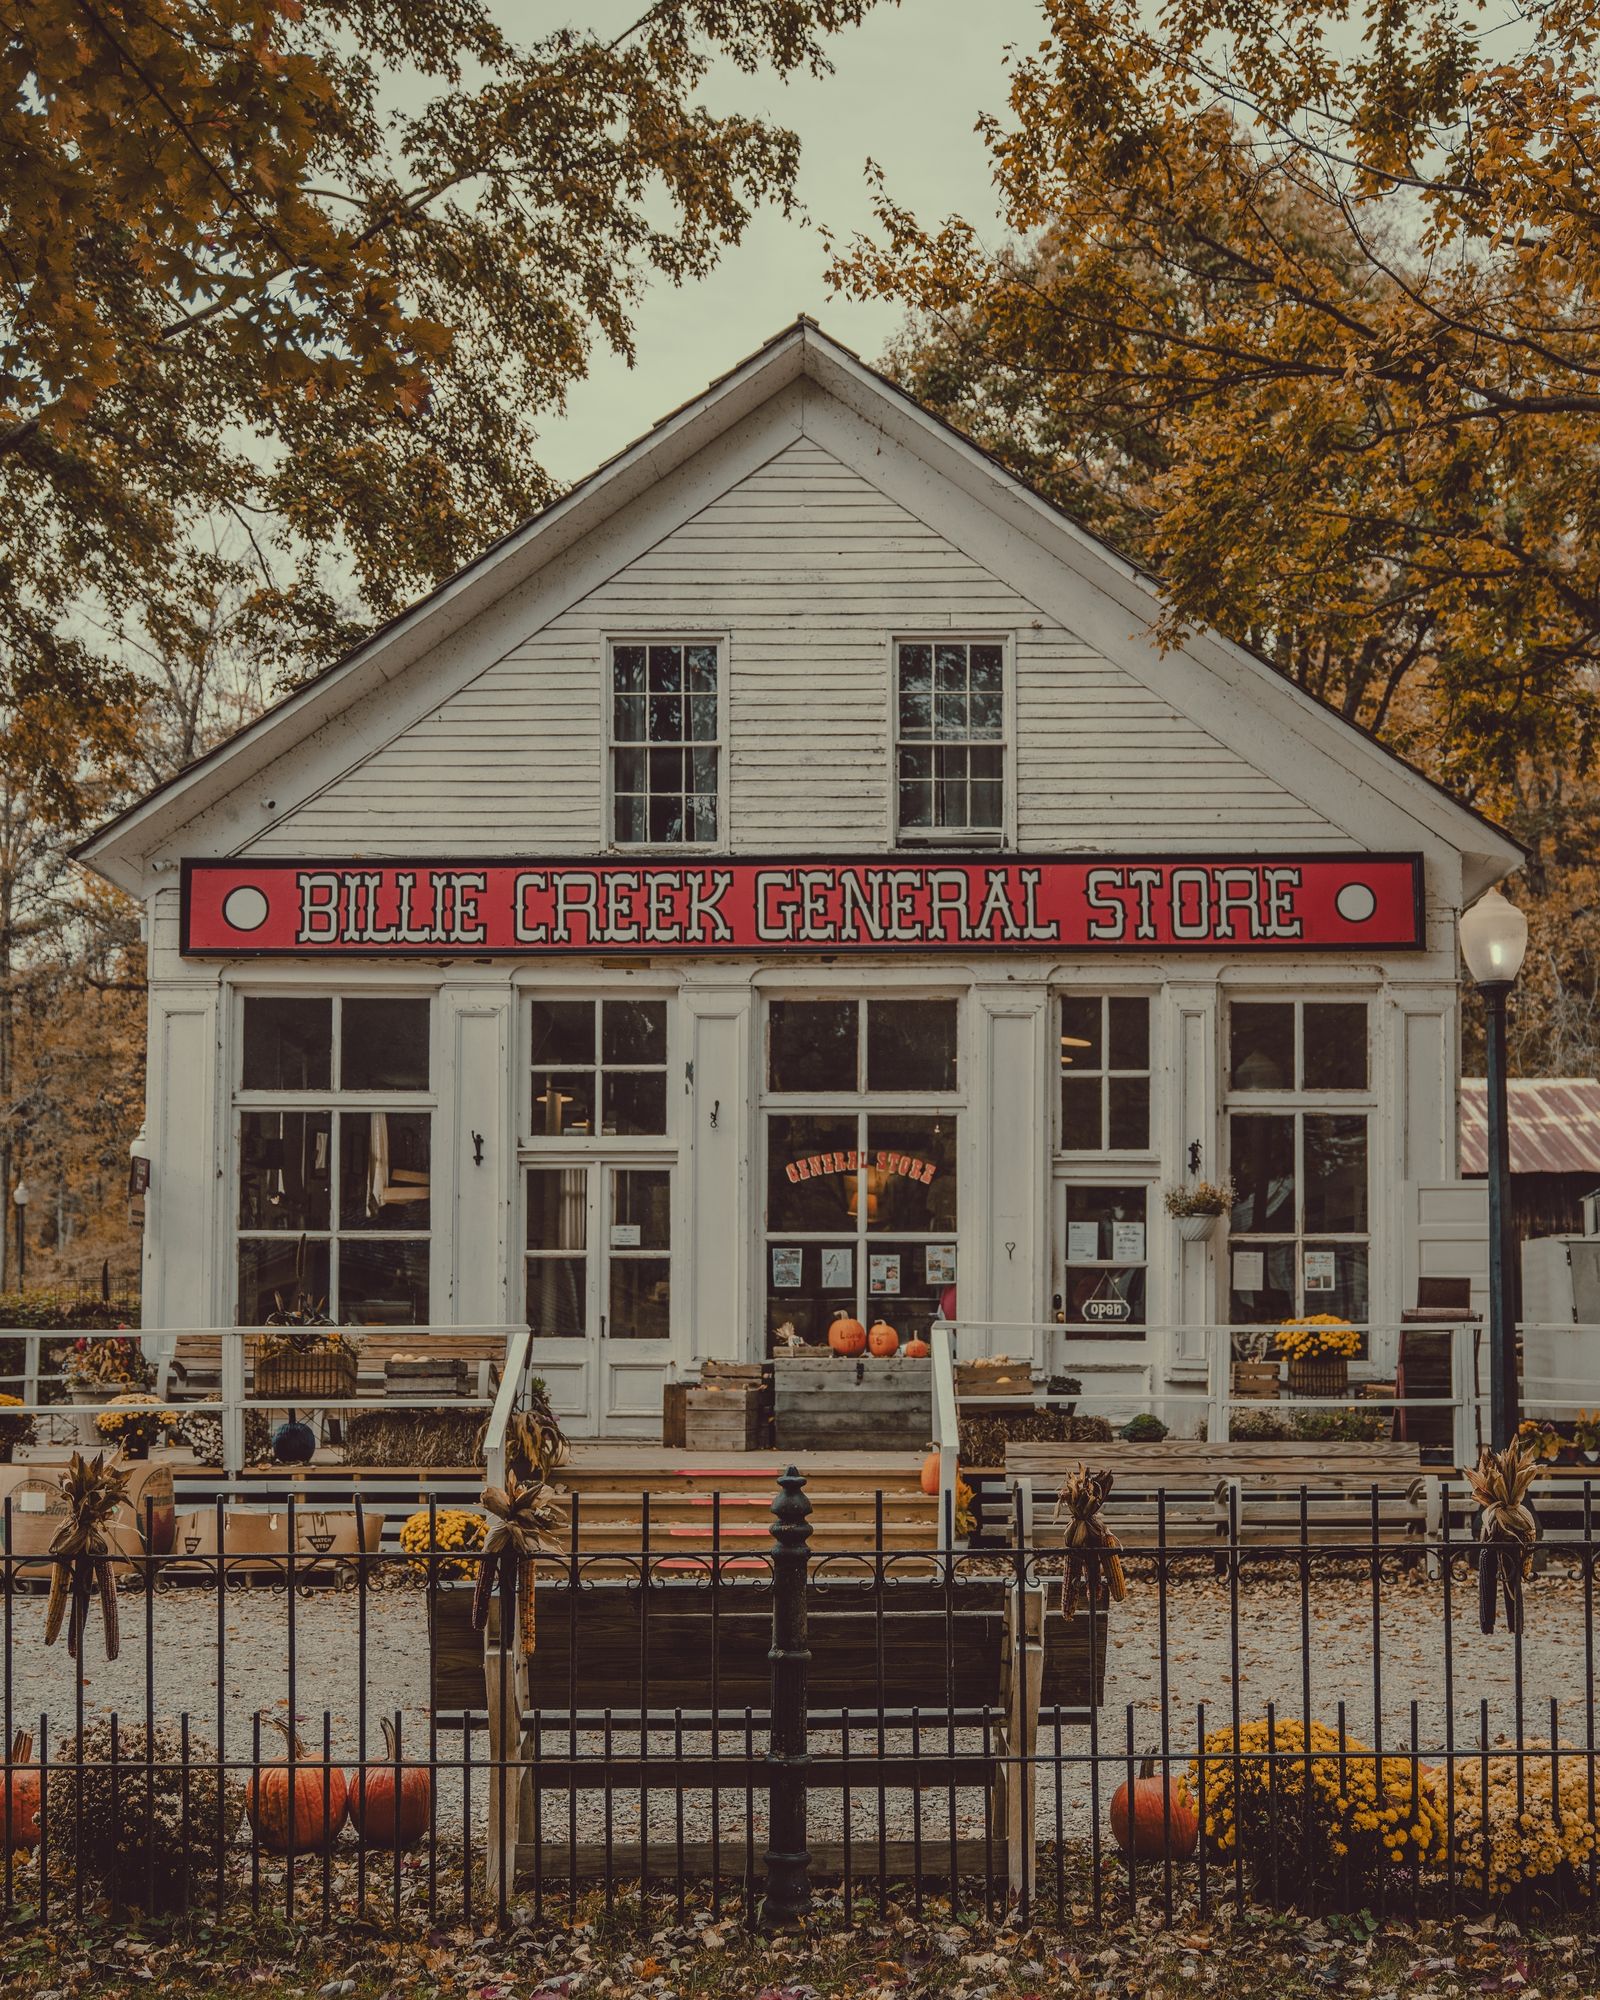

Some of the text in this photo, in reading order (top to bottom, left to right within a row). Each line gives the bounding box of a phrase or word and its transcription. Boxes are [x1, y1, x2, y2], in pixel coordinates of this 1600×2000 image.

[296, 866, 1302, 944] BILLIE CREEK GENERAL STORE
[785, 1151, 937, 1185] GENERAL STORE
[1090, 1303, 1122, 1319] open
